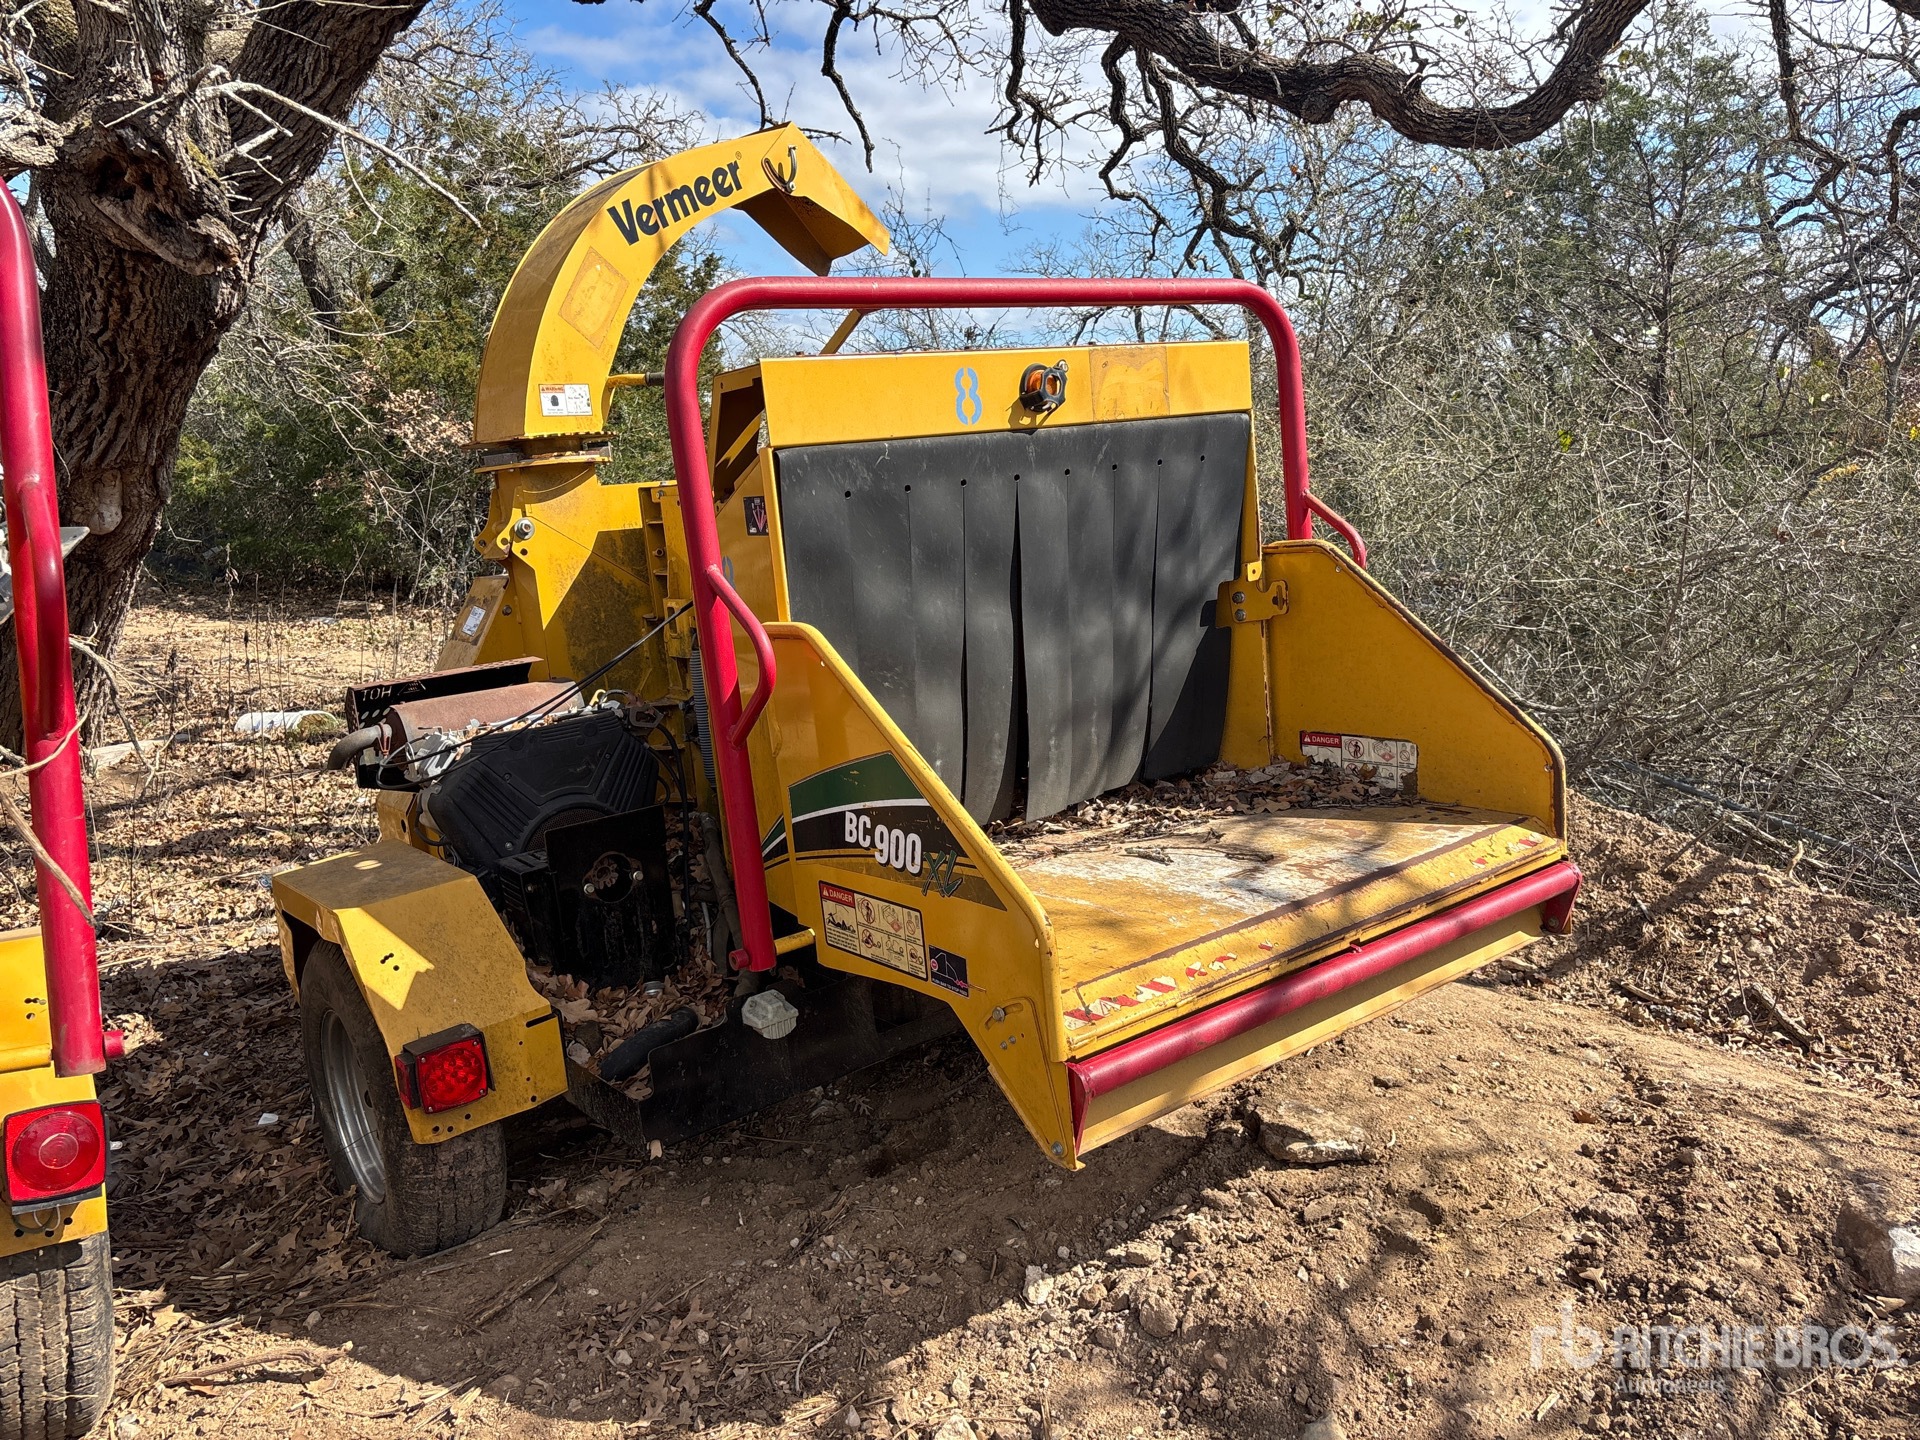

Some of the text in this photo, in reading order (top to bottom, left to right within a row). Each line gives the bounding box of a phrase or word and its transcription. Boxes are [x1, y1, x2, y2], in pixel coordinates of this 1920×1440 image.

[607, 160, 743, 246] Vermeer
[955, 368, 982, 425] 8
[1311, 735, 1340, 745] DANGER
[829, 889, 854, 904] DANGER
[921, 849, 964, 898] XL
